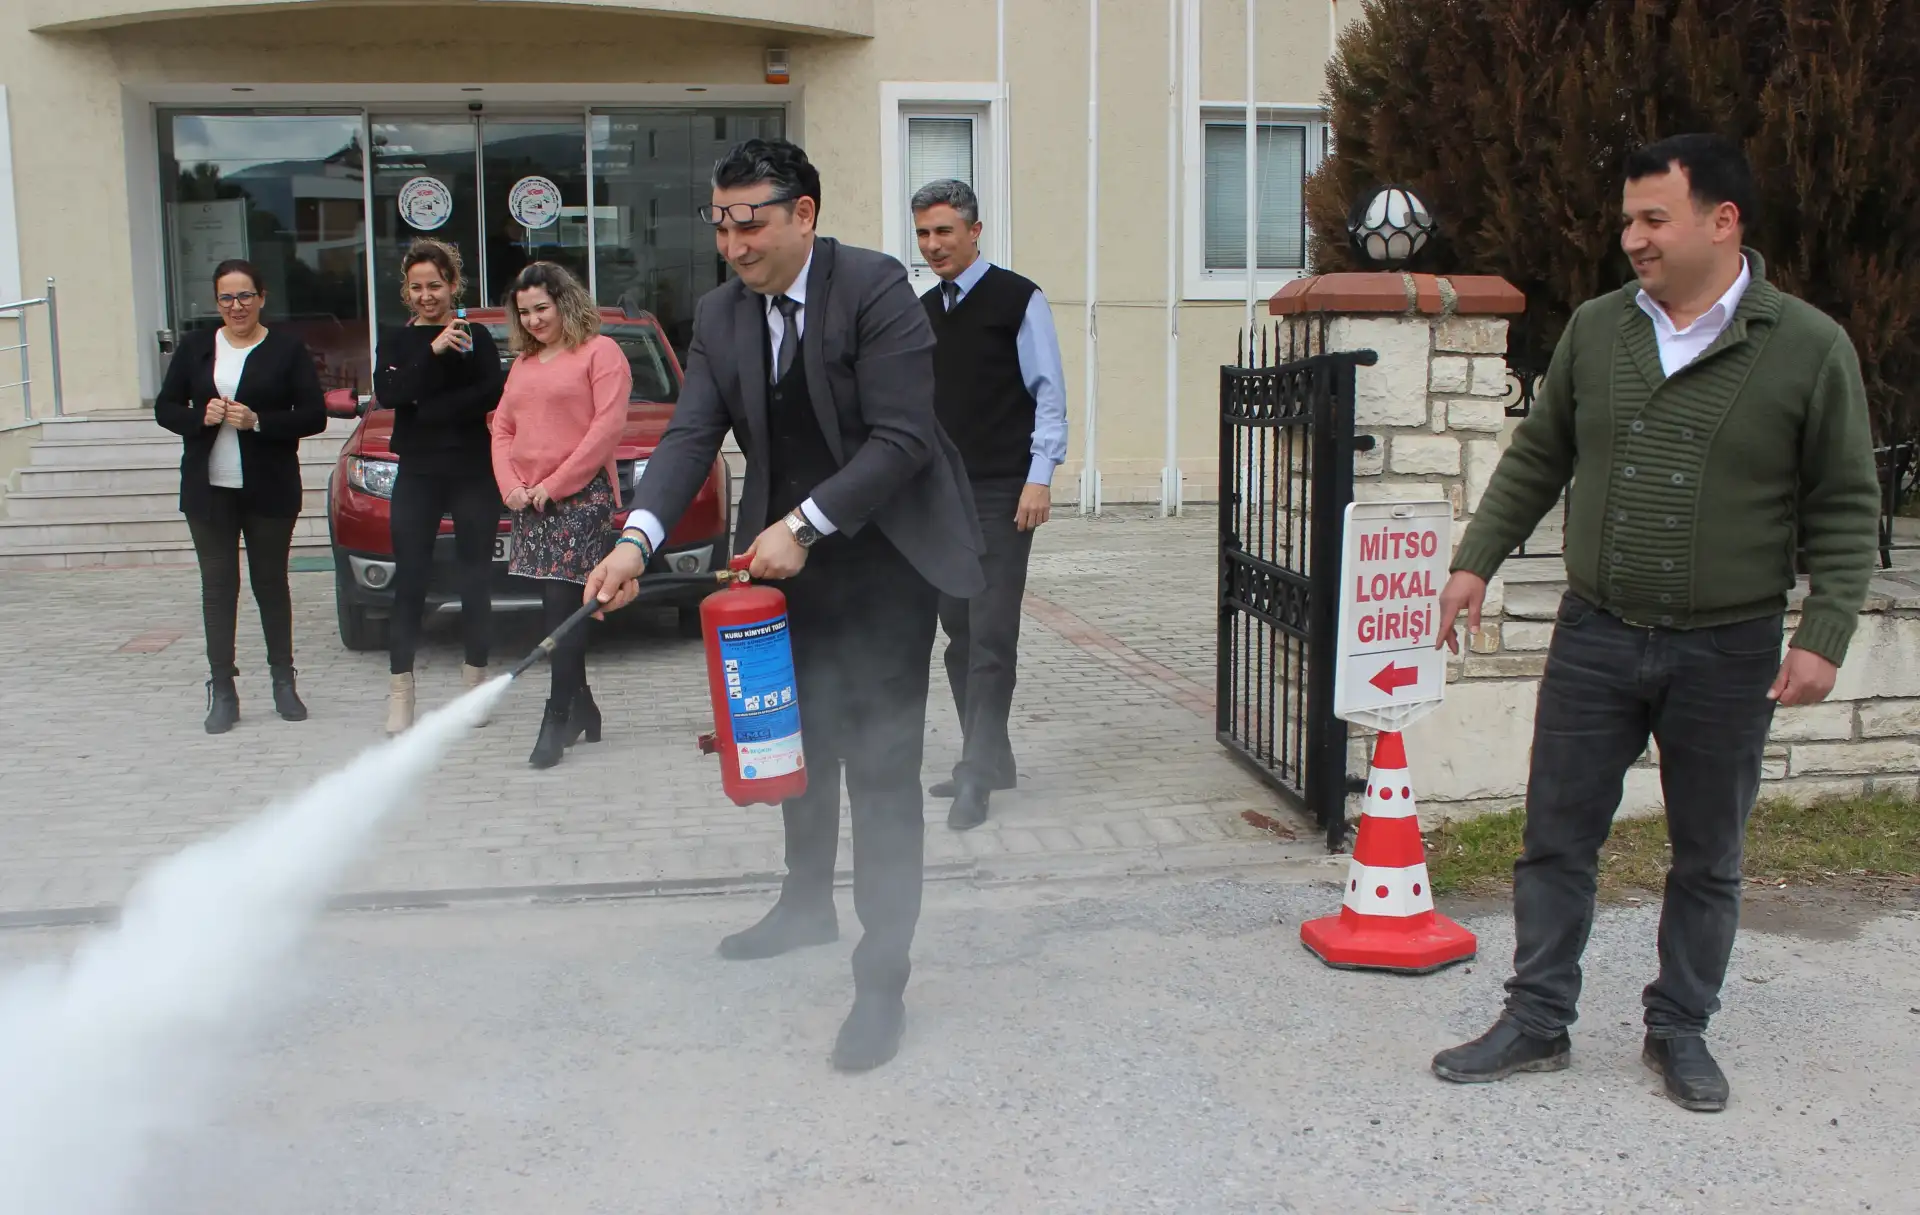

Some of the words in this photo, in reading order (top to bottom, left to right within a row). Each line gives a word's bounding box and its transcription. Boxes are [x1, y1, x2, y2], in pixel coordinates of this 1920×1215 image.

[1359, 526, 1438, 561] MİTSO
[1356, 570, 1437, 603] LOKAL
[744, 624, 771, 637] KİMYEVİ
[1357, 603, 1432, 644] GİRİŞİ
